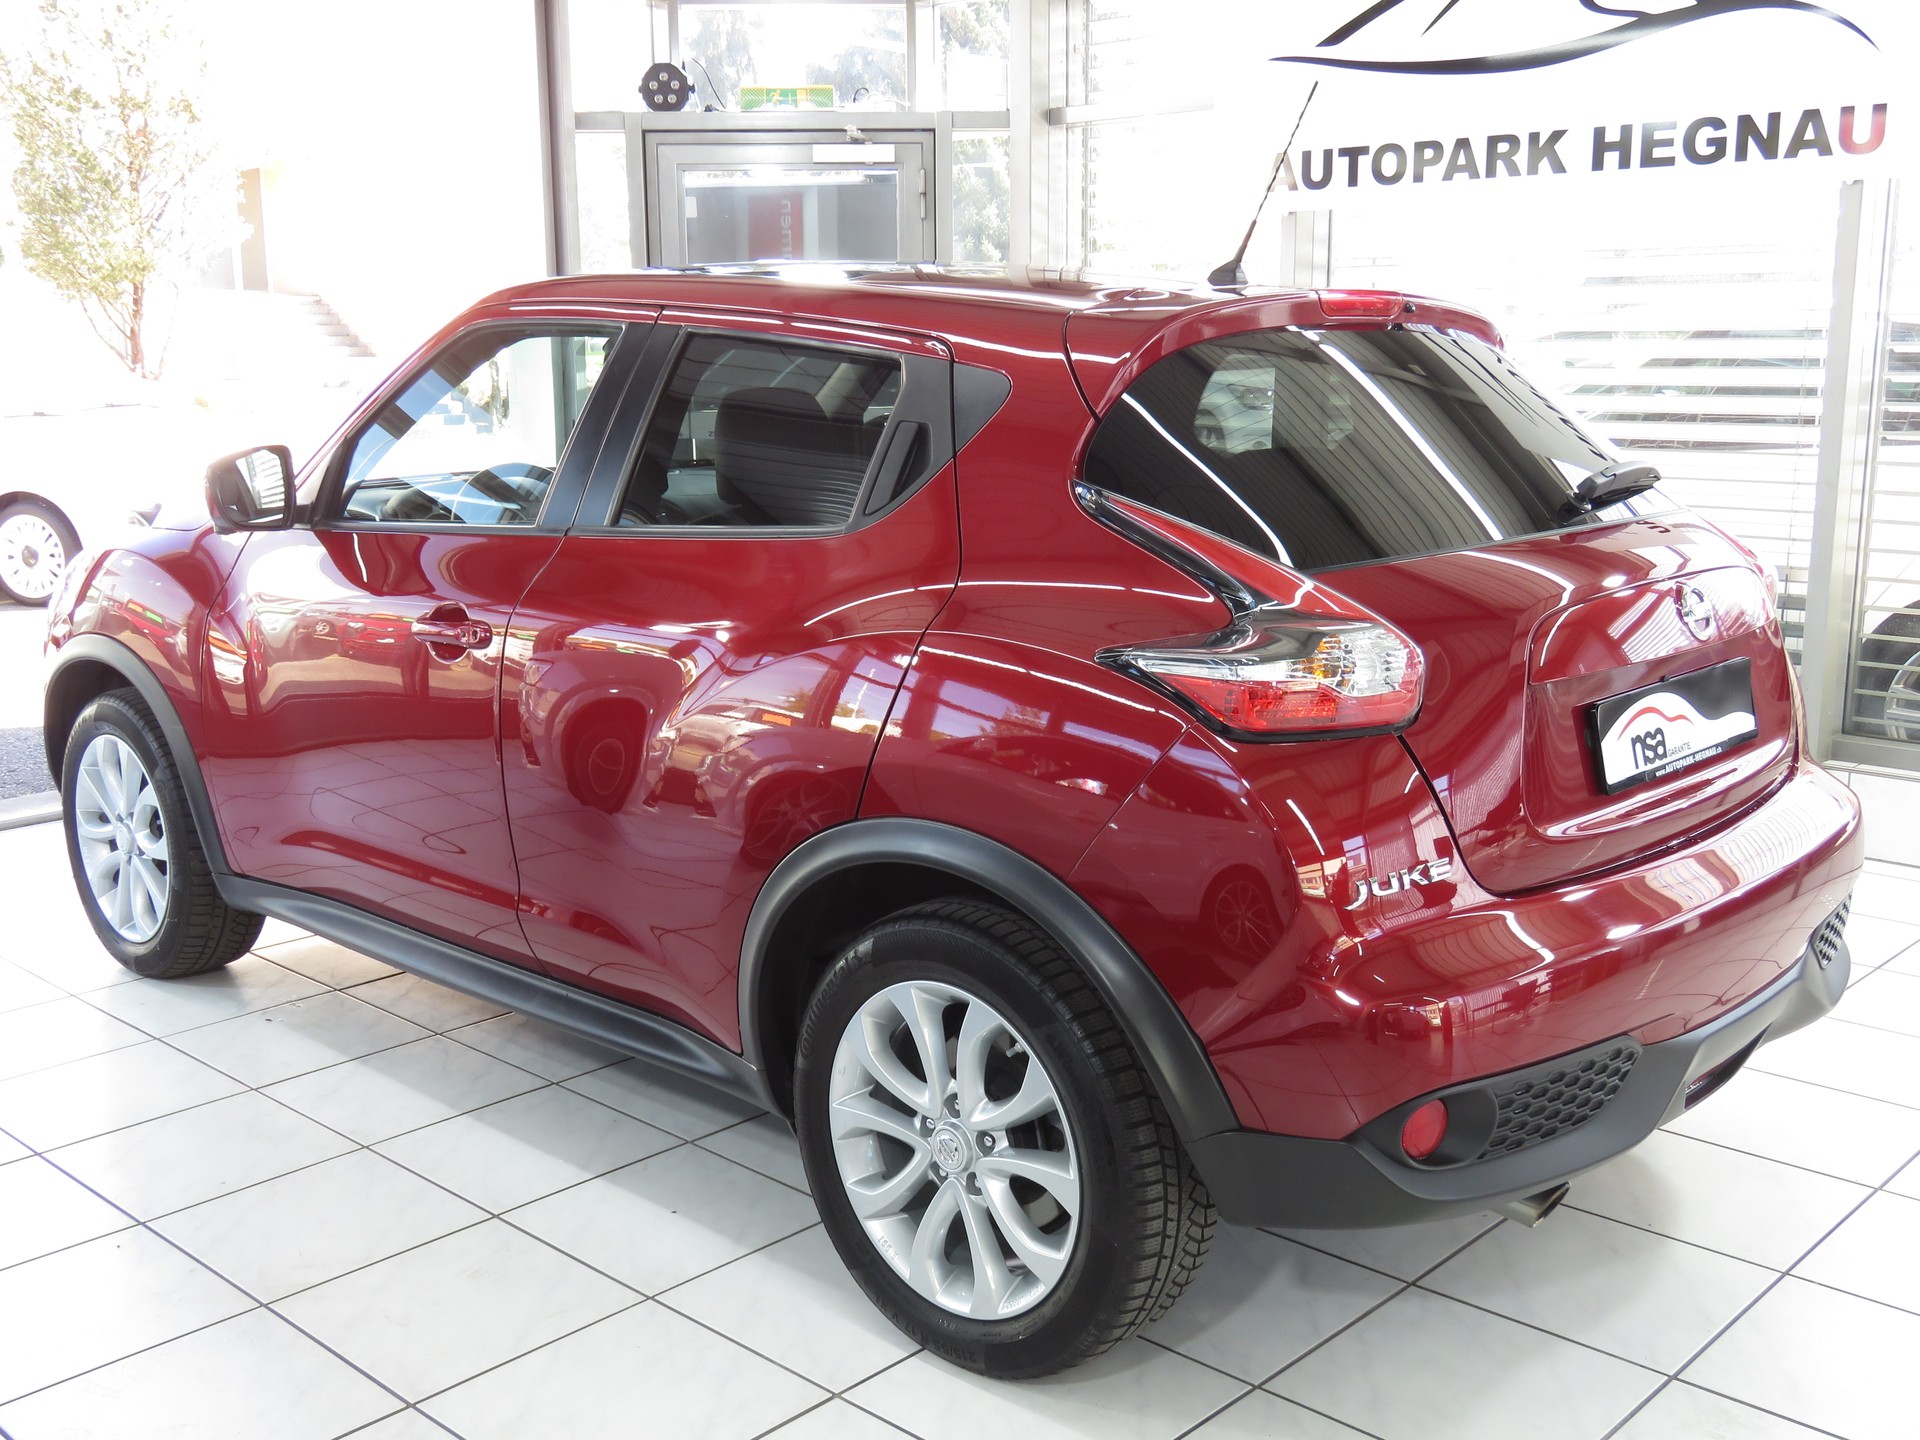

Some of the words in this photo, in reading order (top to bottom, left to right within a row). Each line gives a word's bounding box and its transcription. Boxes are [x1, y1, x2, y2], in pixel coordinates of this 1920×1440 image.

[1266, 129, 1568, 192] AUTOPARK
[1591, 103, 1888, 172] HEGNAU
[1631, 727, 1667, 770] nsa
[1668, 741, 1691, 757] GARANTIE
[1344, 857, 1452, 911] JUKE
